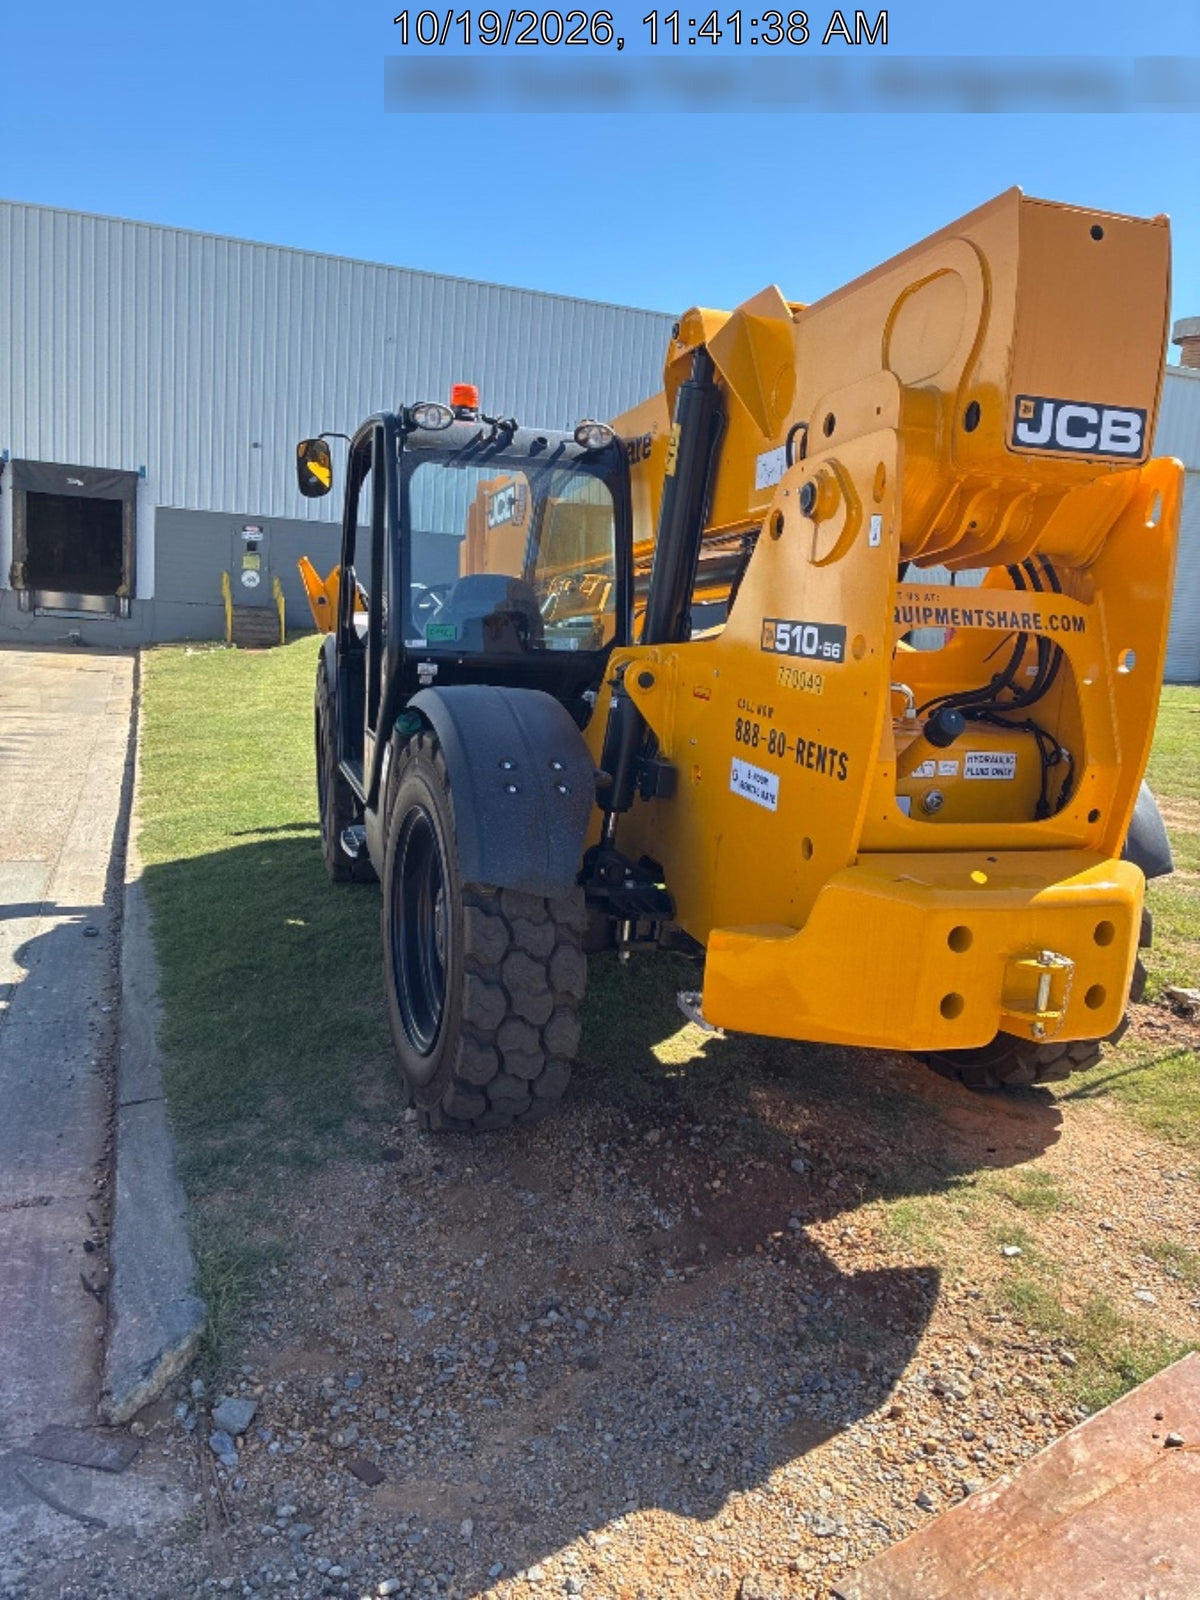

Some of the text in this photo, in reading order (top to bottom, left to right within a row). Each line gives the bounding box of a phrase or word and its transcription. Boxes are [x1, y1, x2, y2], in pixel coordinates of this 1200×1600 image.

[1017, 402, 1142, 453] JCB
[627, 432, 652, 465] are
[893, 605, 1086, 633] QUIPMENTSHARE.COM
[775, 623, 842, 659] 510-56
[735, 717, 849, 781] 888-80-RENTS
